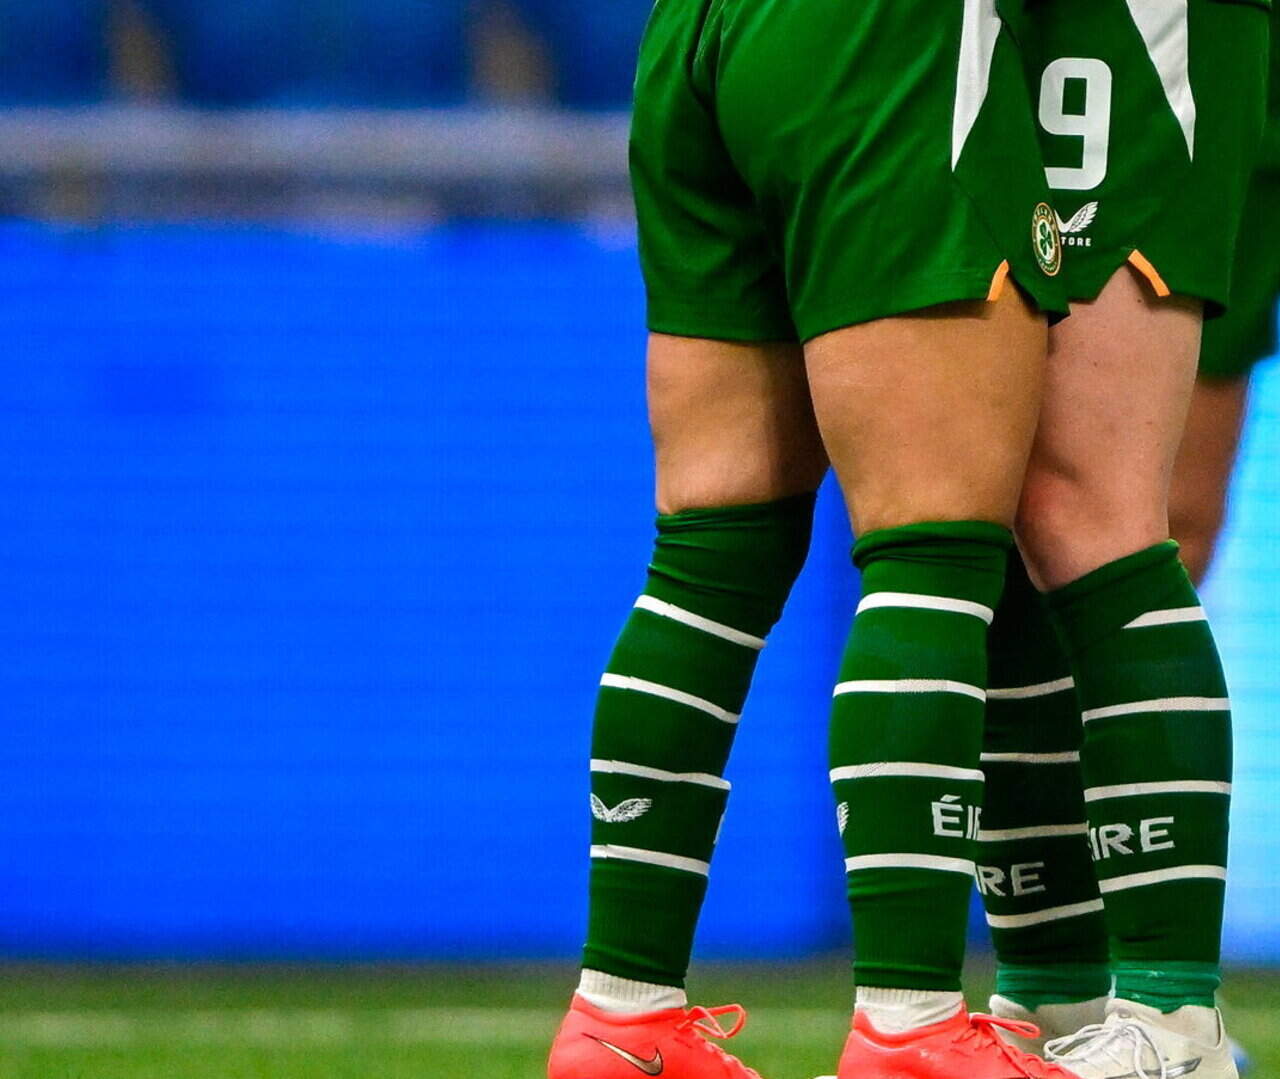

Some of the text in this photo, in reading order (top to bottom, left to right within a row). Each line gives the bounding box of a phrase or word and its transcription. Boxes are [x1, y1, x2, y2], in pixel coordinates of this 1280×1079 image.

[1038, 57, 1113, 191] 9
[1086, 816, 1175, 862] IRE
[975, 861, 1046, 896] RE
